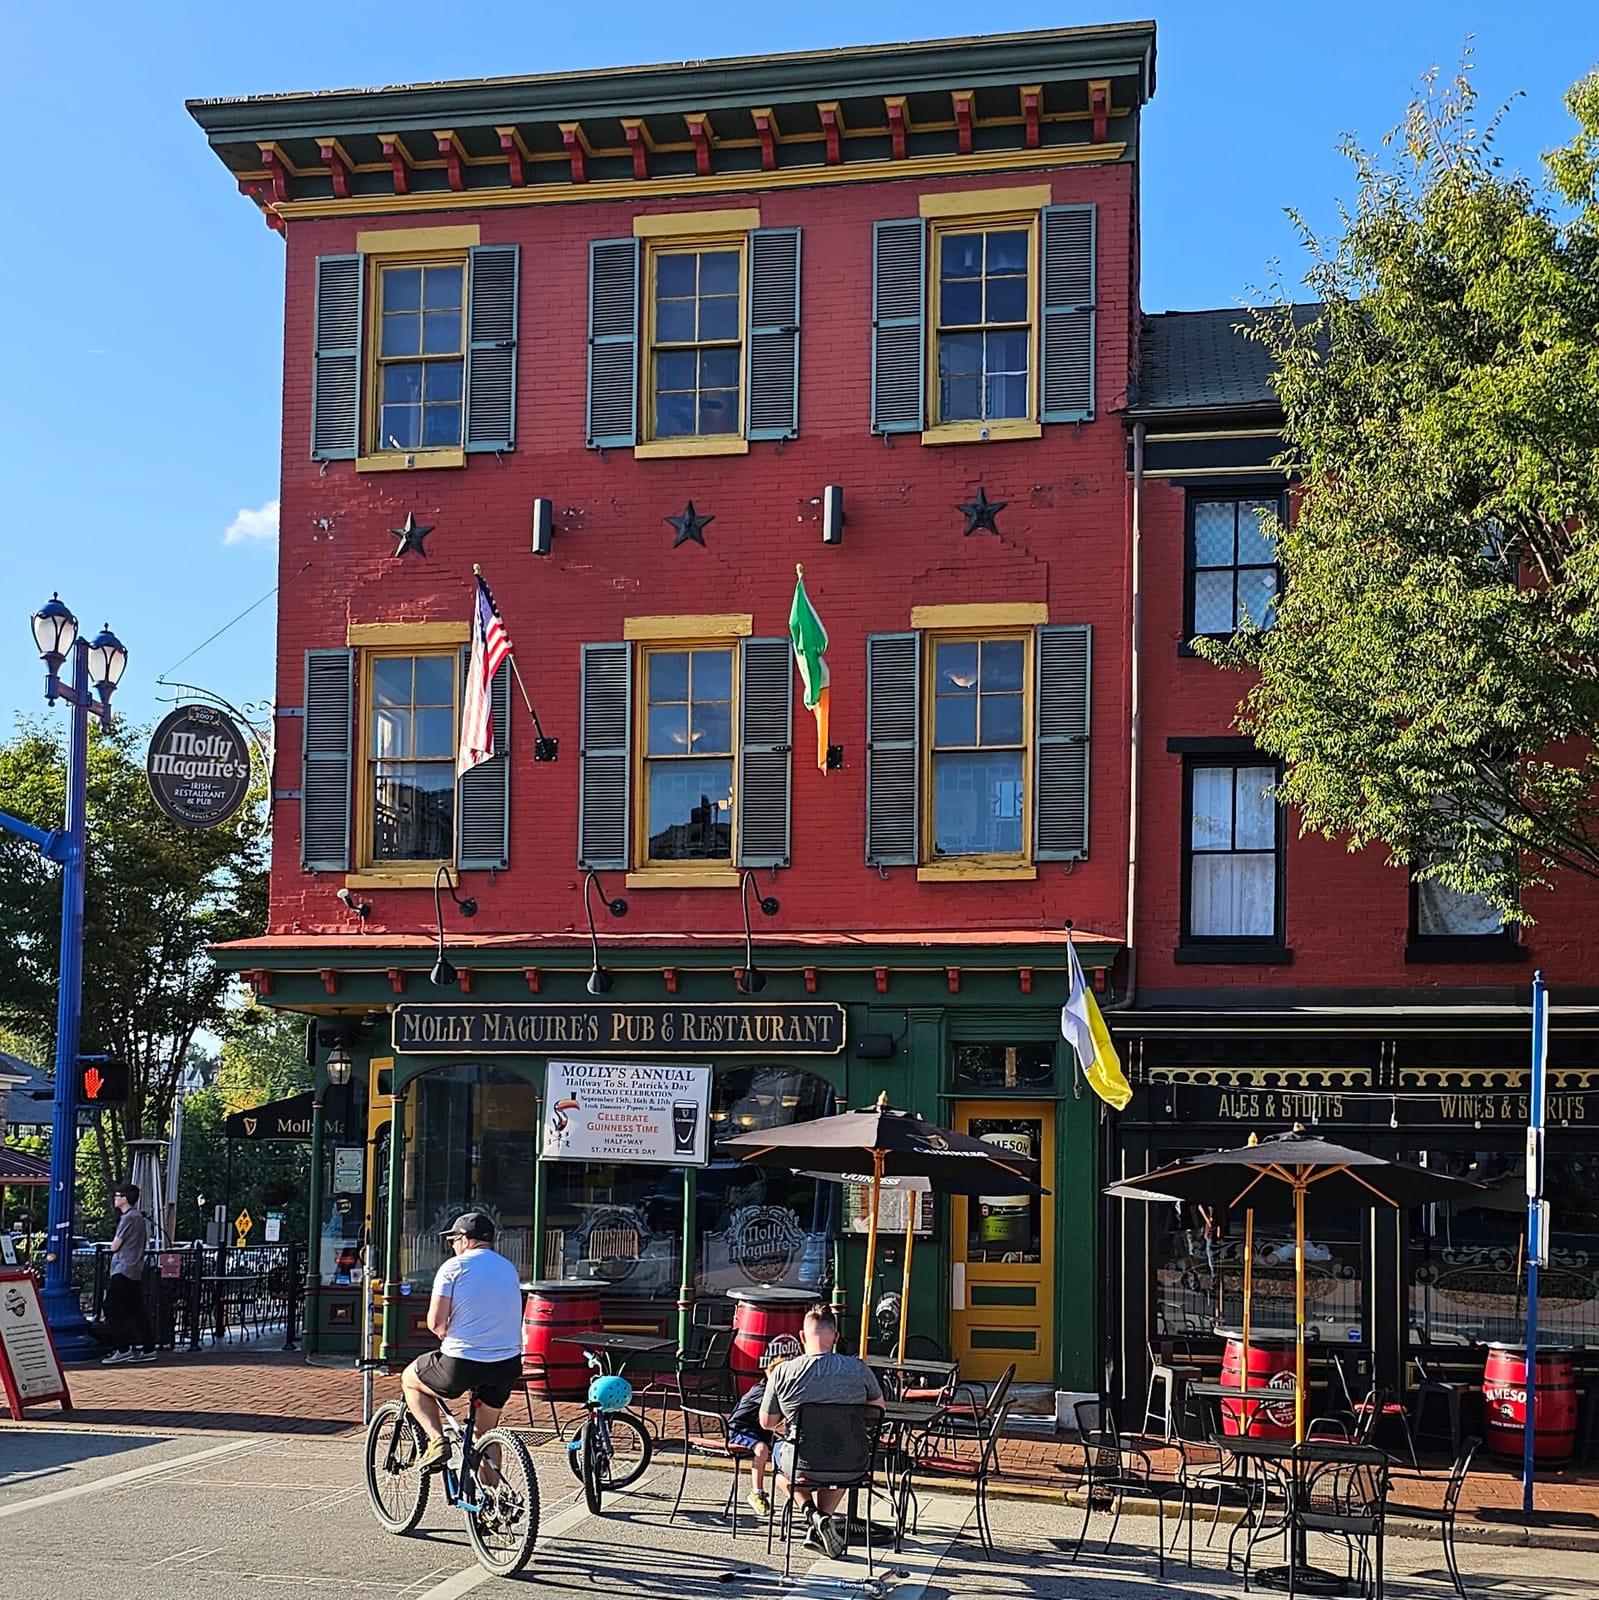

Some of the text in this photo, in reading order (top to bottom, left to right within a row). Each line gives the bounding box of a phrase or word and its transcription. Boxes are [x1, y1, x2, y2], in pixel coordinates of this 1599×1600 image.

[195, 712, 214, 721] 2007
[170, 732, 233, 762] Molly
[152, 754, 248, 780] Maguire's
[190, 782, 211, 791] IRISH
[174, 789, 226, 799] RESTAURANT
[196, 798, 212, 806] PUB
[402, 1012, 834, 1043] MOLLY MAGUIRE'S PUB & RESTAURANT
[561, 1065, 696, 1082] MOLLY'S ANNUAL
[566, 1078, 689, 1092] Halfway To St. Patrick's Day
[580, 1088, 673, 1097] WEEKEND CELEBRATION
[581, 1096, 615, 1104] September
[1218, 1094, 1343, 1118] ALES & STOUTS
[1440, 1095, 1585, 1119] WINES & SRITS
[597, 1112, 649, 1122] CELEBRATE
[277, 1119, 315, 1133] Moll
[586, 1121, 659, 1134] GUINNESS TIME
[840, 1172, 901, 1186] GUINESS
[742, 1223, 787, 1244] Molly
[767, 1341, 801, 1357] Molly
